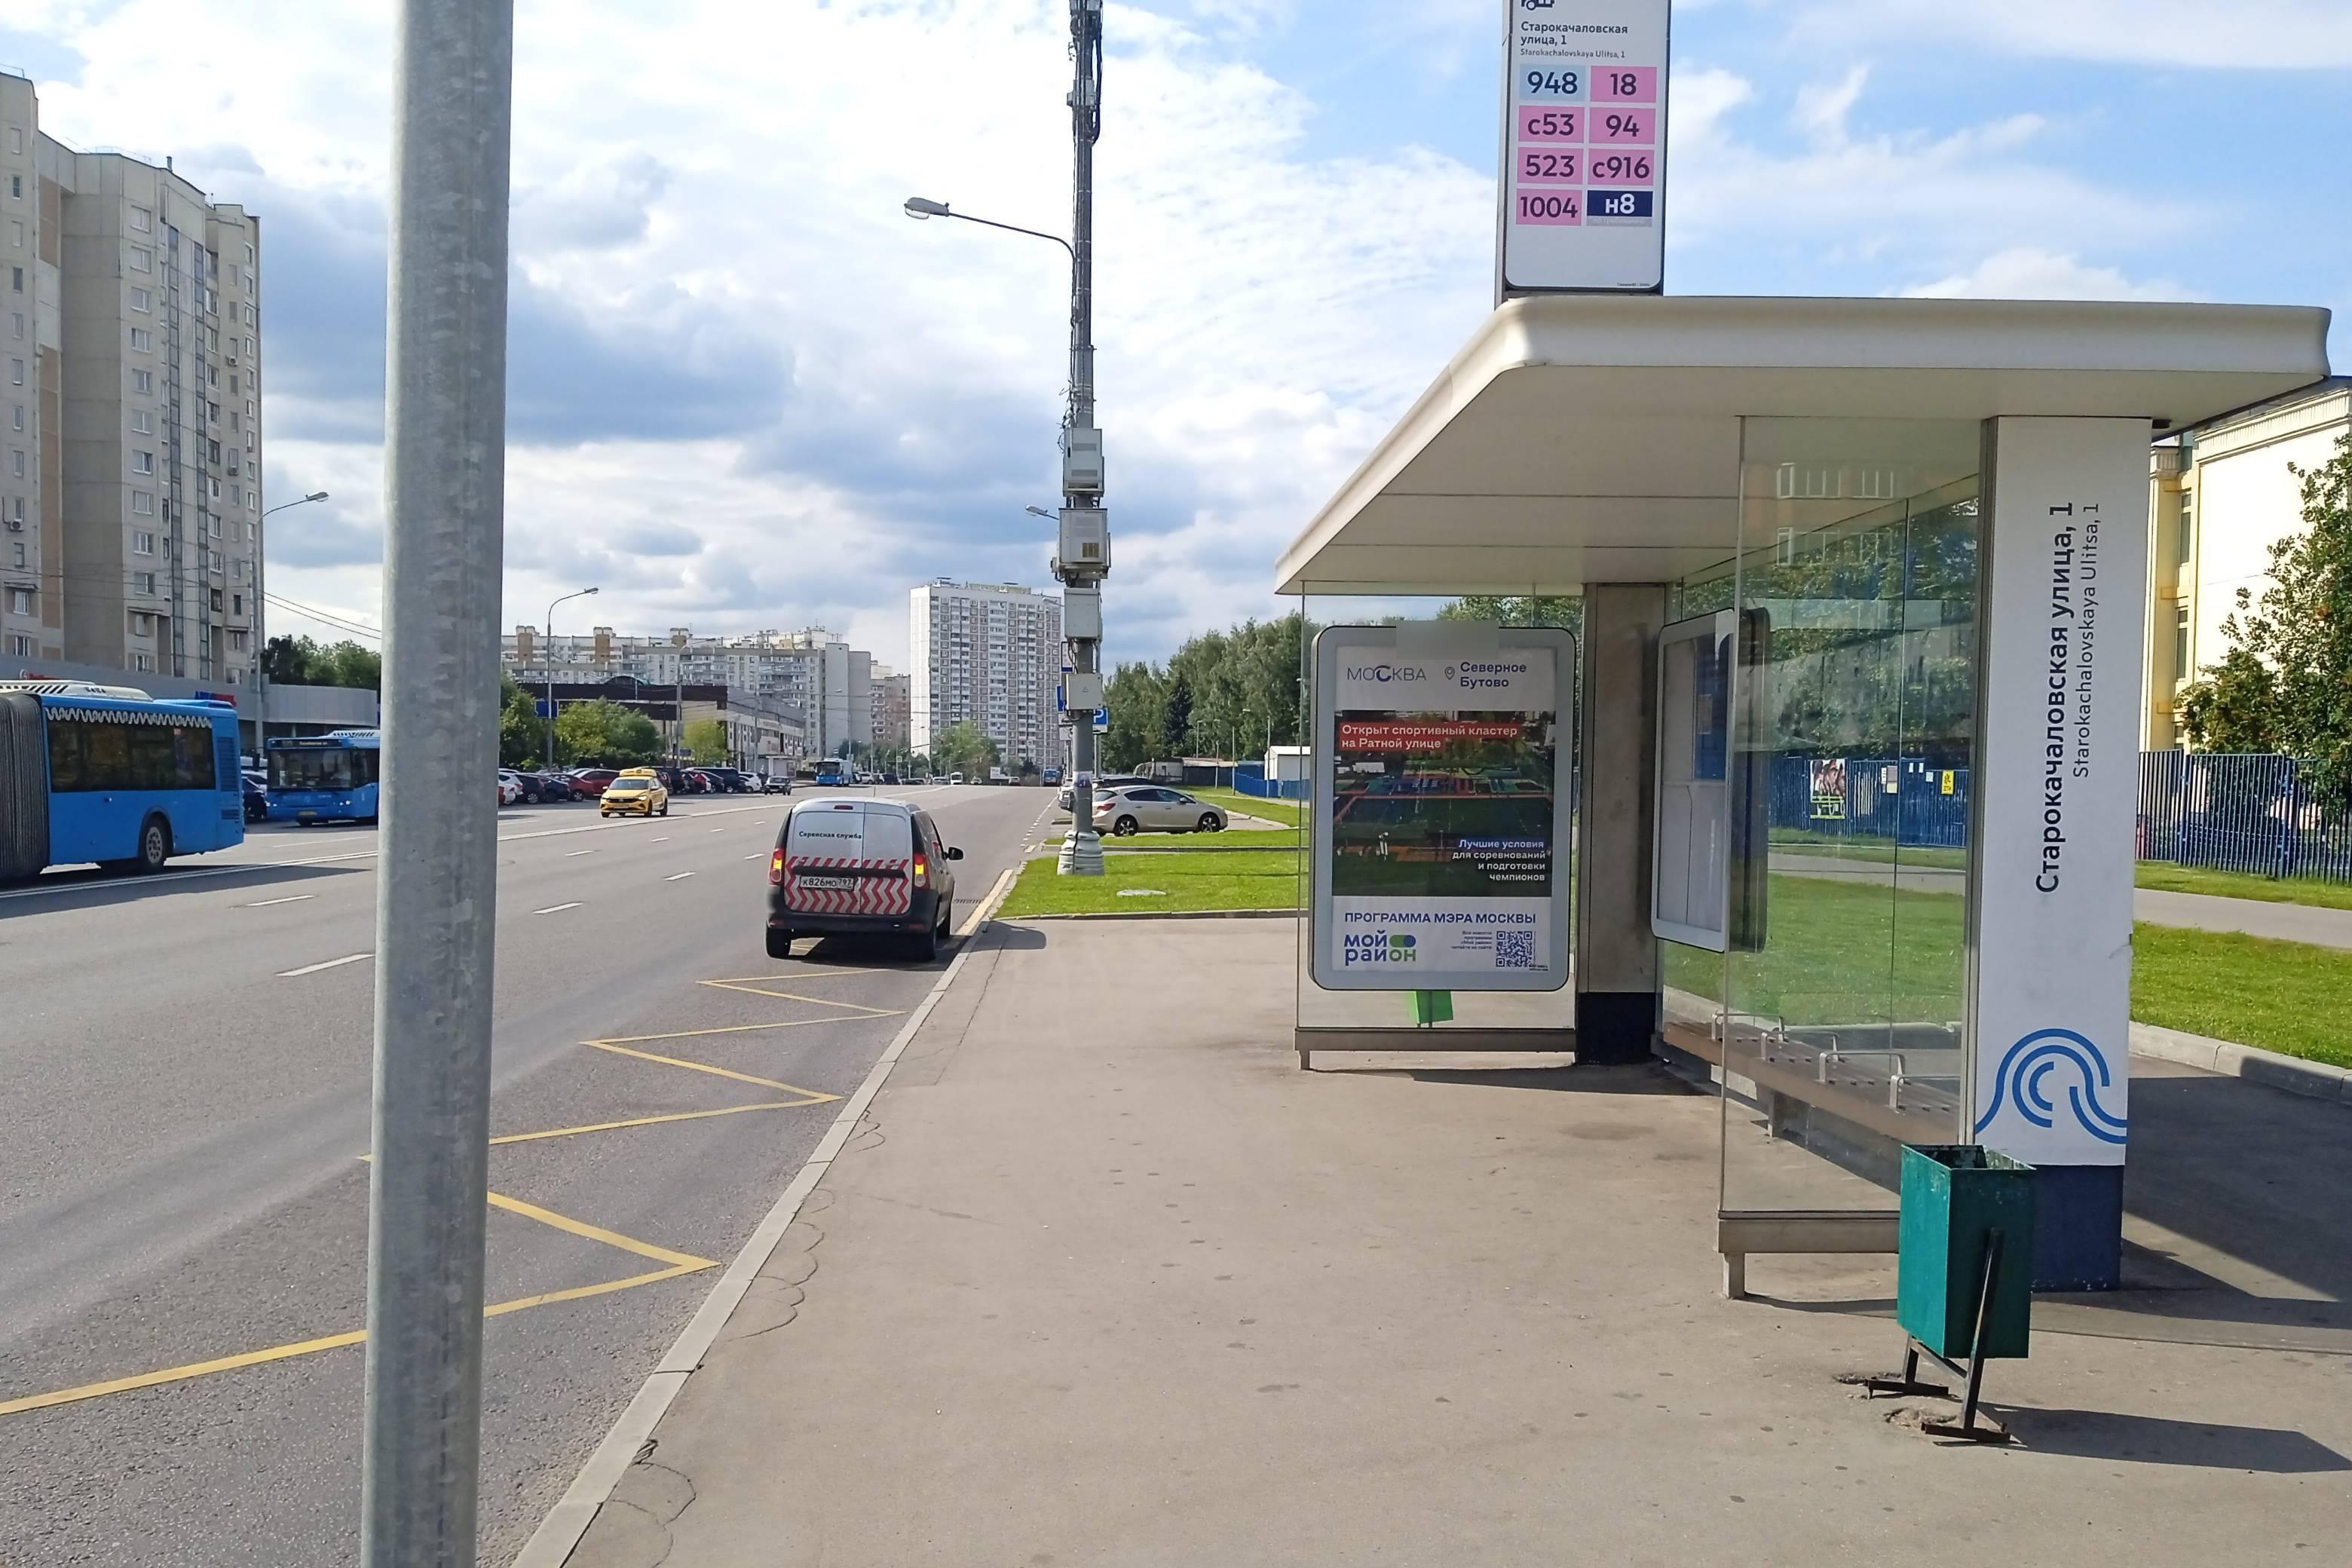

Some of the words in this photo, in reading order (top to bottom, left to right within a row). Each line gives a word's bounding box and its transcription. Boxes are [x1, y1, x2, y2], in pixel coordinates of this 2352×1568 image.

[1521, 21, 1628, 34] Старокачаловская
[1521, 36, 1557, 46] улица,
[1560, 35, 1567, 45] 1
[1520, 48, 1594, 58] Starokachalovskaya
[1595, 51, 1619, 59] Ulitsa,
[1527, 71, 1578, 94] 948
[1609, 73, 1637, 96] 18
[1527, 114, 1574, 136] с53
[1606, 115, 1640, 137] 94
[1525, 155, 1575, 177] 523
[1592, 156, 1649, 179] с916
[1521, 196, 1578, 218] 1004
[1605, 193, 1635, 214] н8
[2049, 502, 2072, 516] 1
[2083, 504, 2099, 513] 1
[2080, 519, 2101, 580] Ulitsa,
[2052, 526, 2076, 619] улица,
[1347, 665, 1427, 682] МОСКВА
[1460, 662, 1527, 675] Северное
[1459, 677, 1509, 689] Бутово
[2073, 587, 2098, 777] Starokachalovskaya
[1094, 709, 1104, 723] P
[1342, 724, 1389, 735] Открыт
[1392, 726, 1465, 737] спортивный
[1468, 727, 1517, 737] кластер
[1358, 738, 1402, 749] Ратной
[1405, 740, 1441, 750] улице
[2035, 627, 2068, 893] Старокачаловская
[1459, 839, 1500, 850] Лучшие
[1502, 841, 1544, 850] условия
[1473, 850, 1545, 860] соревнований
[1345, 912, 1431, 923] ПРОГРАММА
[1435, 913, 1472, 923] МЭРА
[1476, 914, 1536, 924] МОСКВЫ
[1344, 929, 1387, 948] мой
